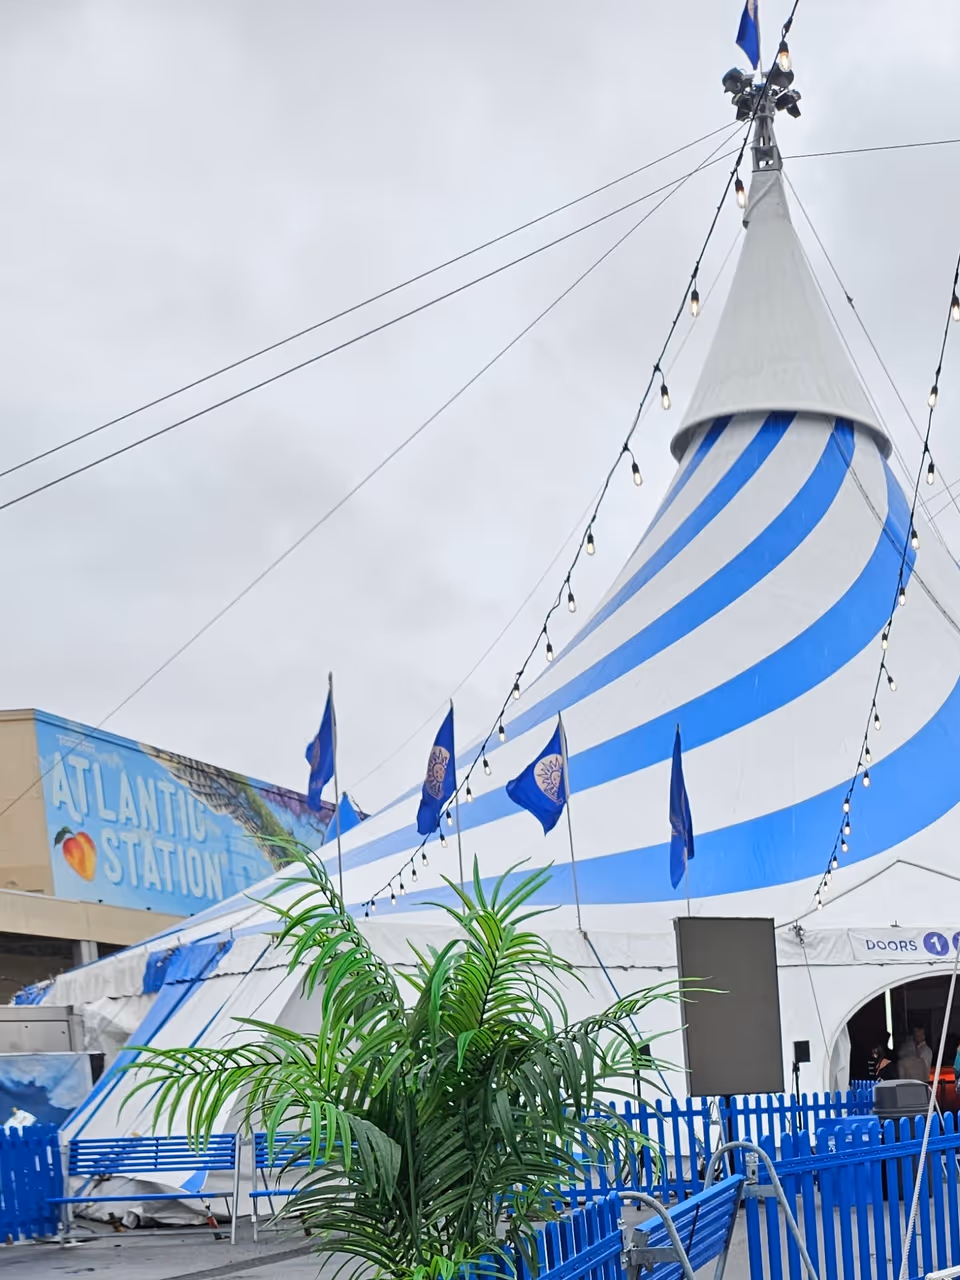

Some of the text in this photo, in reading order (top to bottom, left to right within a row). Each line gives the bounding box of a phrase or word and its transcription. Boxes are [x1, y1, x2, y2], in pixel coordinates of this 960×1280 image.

[52, 751, 208, 842] ATLANTIC
[102, 828, 223, 900] STATION
[866, 939, 918, 951] DOORS
